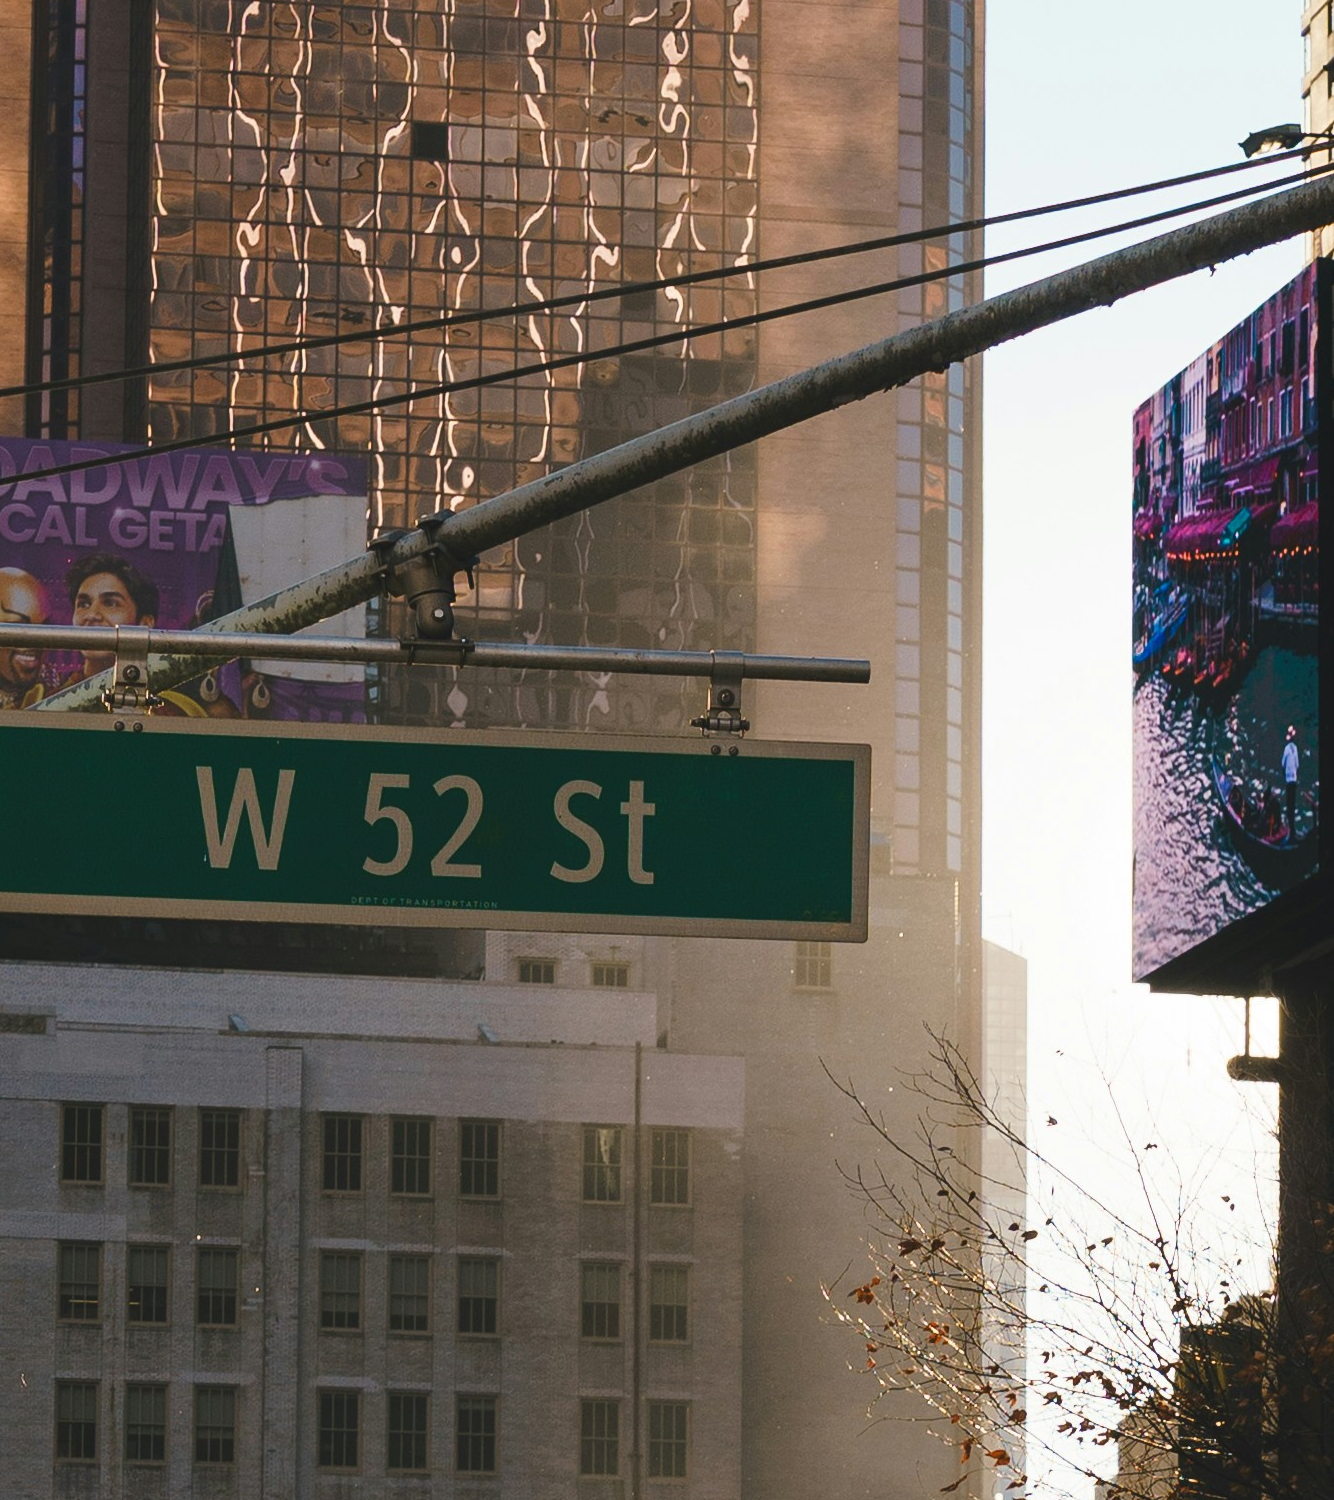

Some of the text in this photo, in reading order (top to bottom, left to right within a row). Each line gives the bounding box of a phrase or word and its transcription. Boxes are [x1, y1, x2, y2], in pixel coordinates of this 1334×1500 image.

[108, 506, 227, 553] GETA
[195, 765, 656, 886] W 52 St
[399, 897, 499, 910] TRANSPORTATION
